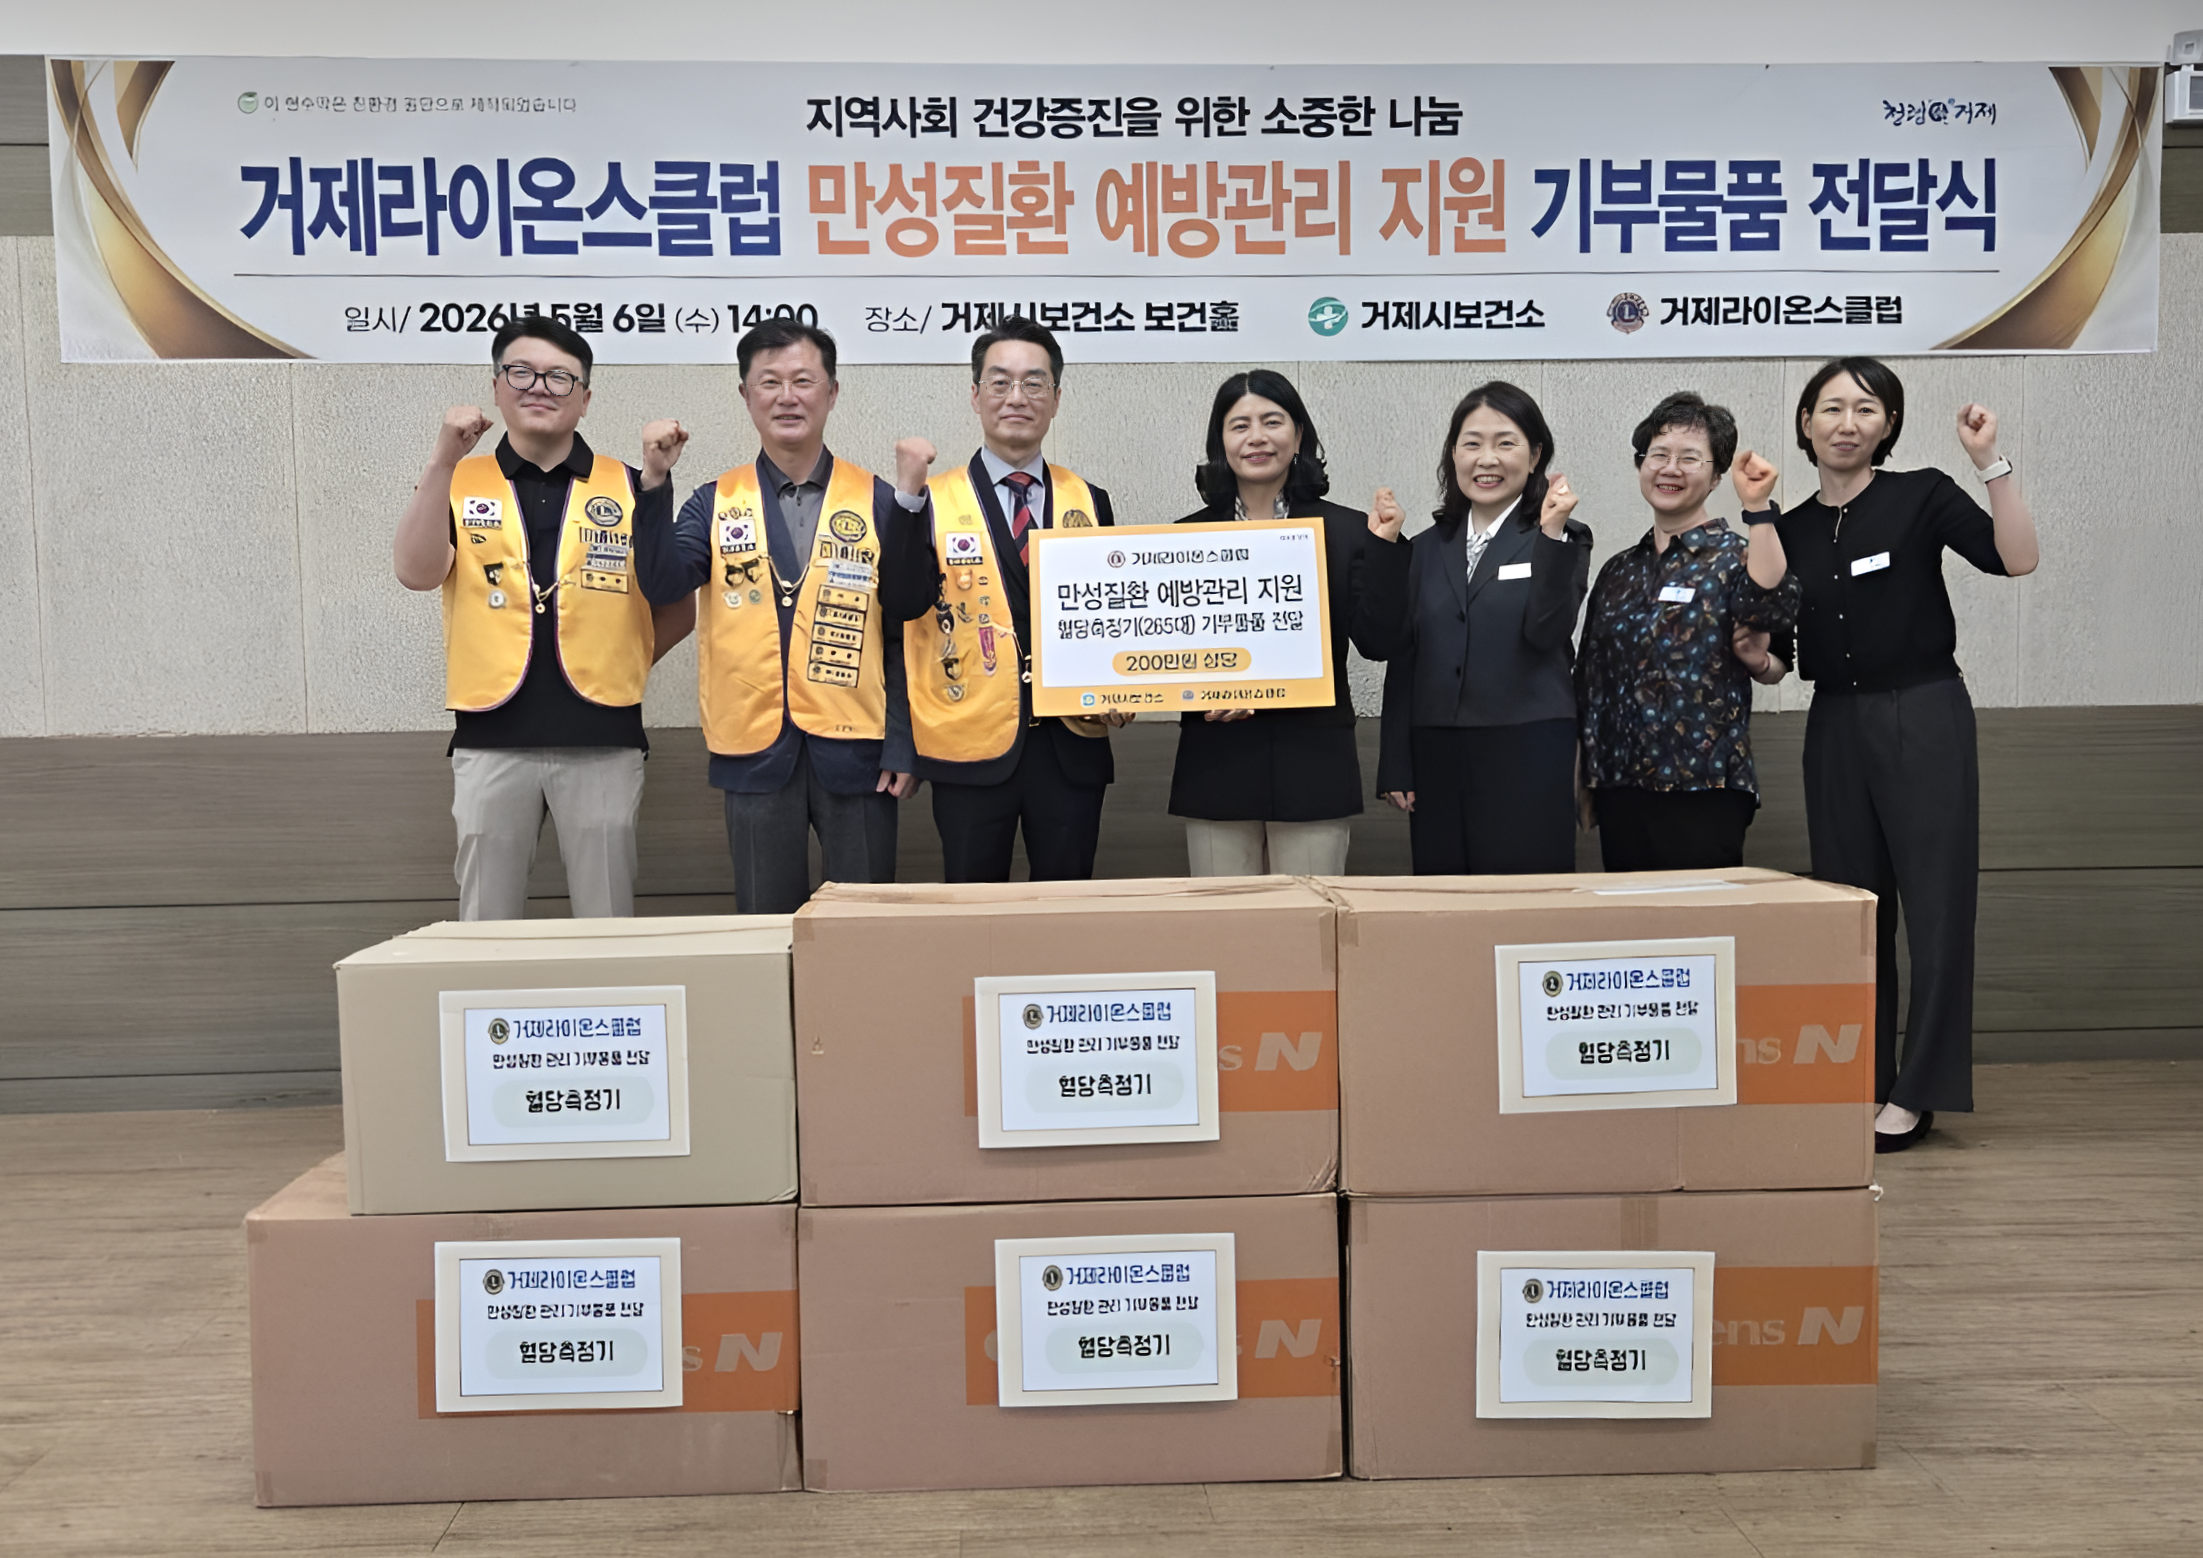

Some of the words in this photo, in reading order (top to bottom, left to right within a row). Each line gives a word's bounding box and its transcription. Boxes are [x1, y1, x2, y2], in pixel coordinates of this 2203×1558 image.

[265, 96, 279, 112] 이
[806, 95, 958, 139] 지역사회
[972, 96, 1163, 140] 건강증진을
[1174, 95, 1251, 139] 위한
[1260, 95, 1377, 139] 소중한
[1389, 95, 1464, 137] 나눔
[240, 156, 782, 257] 거제라이온스클럽
[807, 159, 1076, 258] 만성질환
[1095, 159, 1352, 259] 예방관리
[1378, 156, 1508, 257] 지원
[1530, 157, 1788, 254] 기부물품
[1808, 157, 1997, 253] 전달식
[344, 305, 412, 335] 일시/
[551, 302, 603, 333] 5월
[612, 302, 667, 333] 6일
[675, 307, 720, 334] (수)
[865, 305, 933, 335] 장소/
[1361, 299, 1546, 331] 거제시보건소
[1660, 294, 1903, 326] 거제라이온스클럽
[1058, 581, 1149, 611] 만성질환
[1158, 576, 1248, 608] 예방관리
[1257, 574, 1304, 603] 지원
[1254, 1031, 1323, 1072] N
[1578, 1039, 1670, 1064] 혈당측정기
[1793, 1024, 1863, 1065] N
[525, 1088, 621, 1113] 혈당측정기
[1058, 1073, 1152, 1098] 혈당측정기
[1254, 1318, 1322, 1359] N
[1798, 1306, 1864, 1345] N
[519, 1340, 614, 1364] 혈당측정기
[714, 1332, 783, 1373] N
[1078, 1334, 1170, 1359] 혈당측정기
[1556, 1348, 1646, 1372] 혈당측정기
